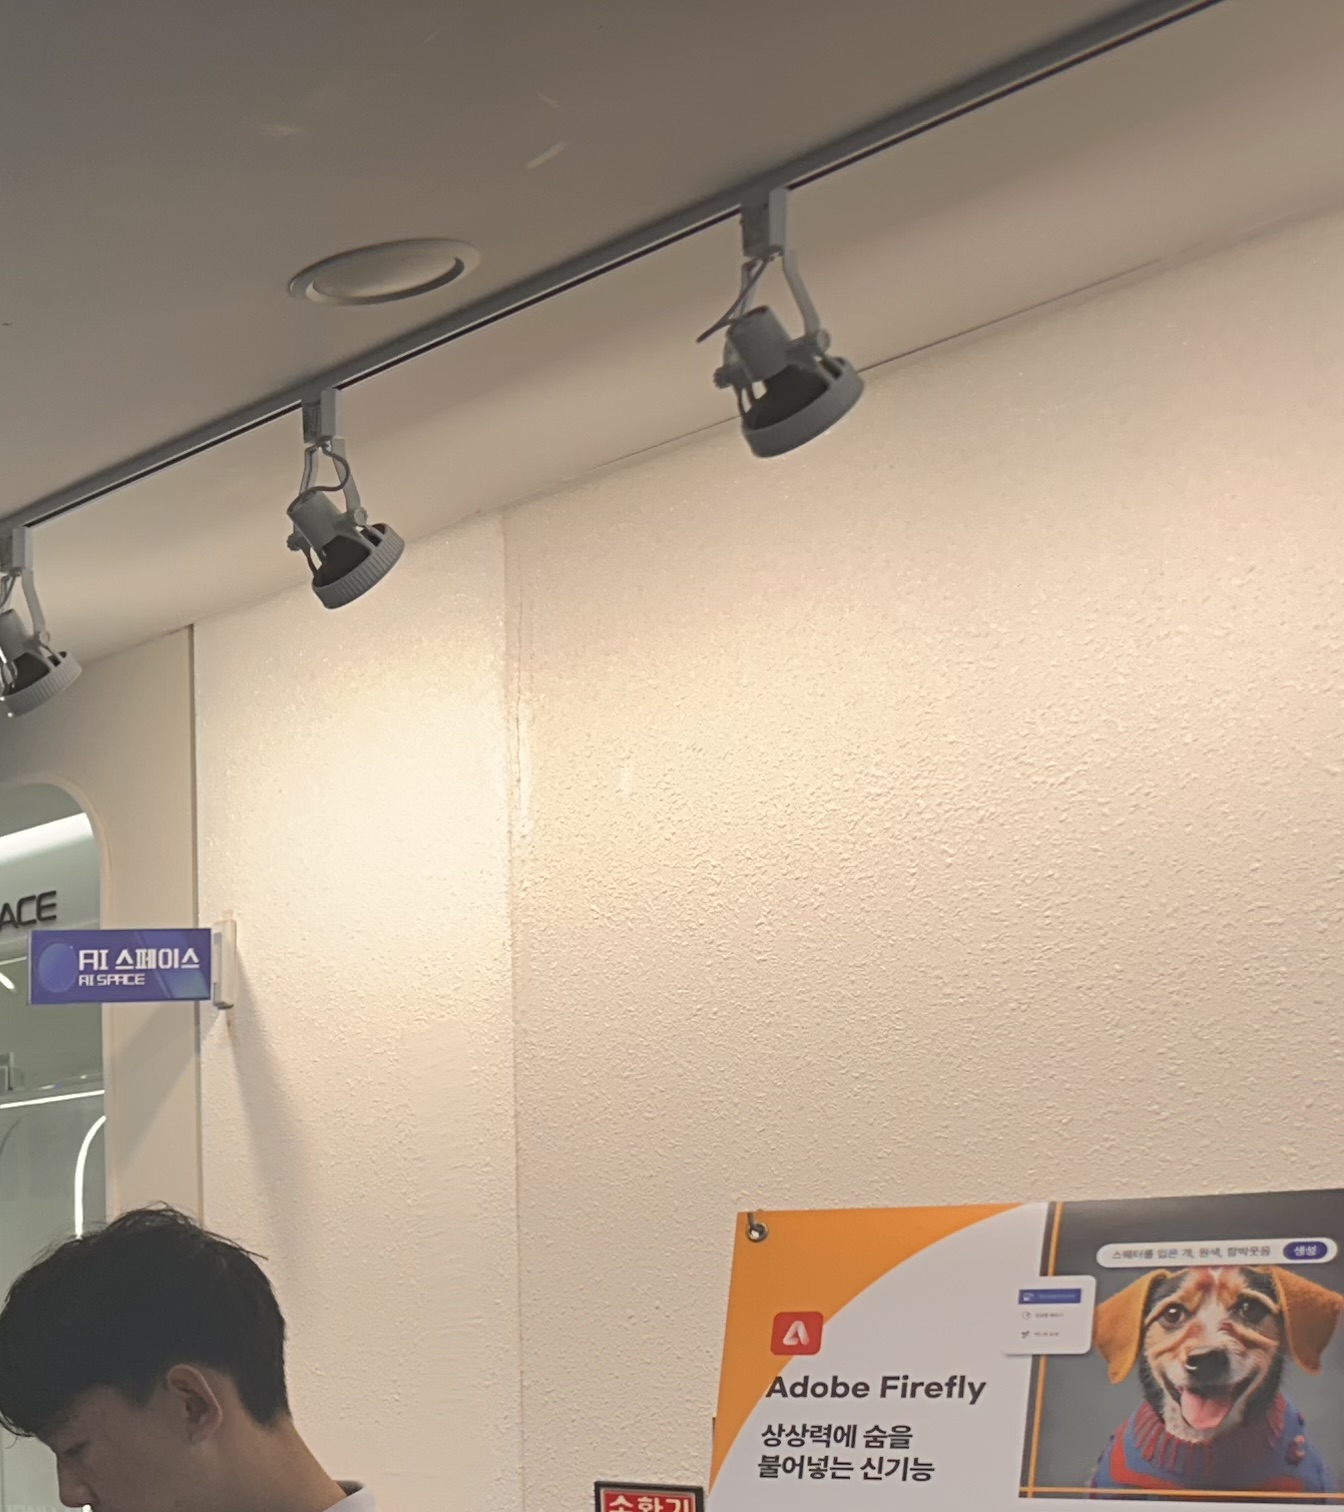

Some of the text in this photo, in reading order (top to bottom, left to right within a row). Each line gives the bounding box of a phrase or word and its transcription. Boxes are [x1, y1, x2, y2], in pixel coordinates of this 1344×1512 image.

[78, 947, 201, 972] AI 스페이스
[78, 972, 146, 987] AI SPACE
[765, 1374, 986, 1404] Adobe Firefly
[761, 1423, 912, 1449] 상상력에 숨을
[758, 1454, 935, 1482] 불어넣는 신기능
